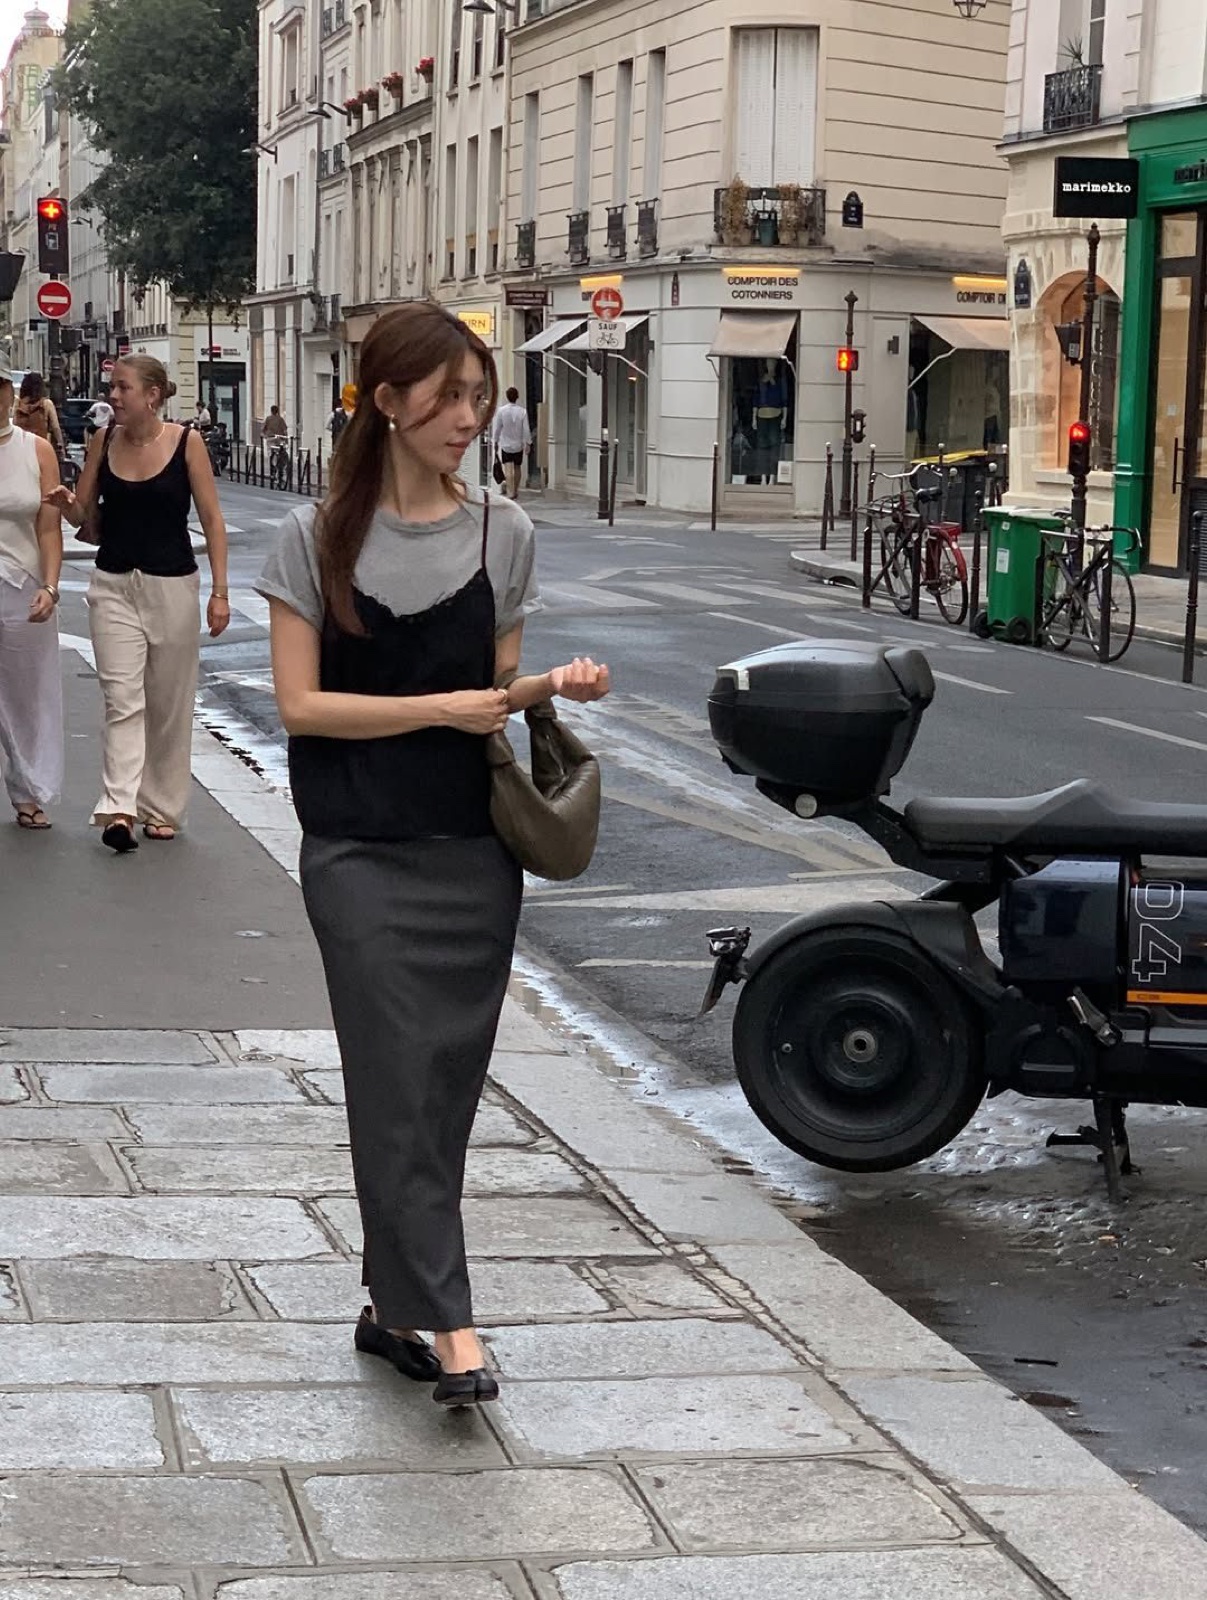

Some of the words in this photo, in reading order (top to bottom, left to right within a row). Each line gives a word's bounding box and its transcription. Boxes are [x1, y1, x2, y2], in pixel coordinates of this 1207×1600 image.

[1062, 181, 1131, 193] marimekko
[727, 276, 777, 286] COMPTOIR
[778, 277, 798, 286] DES
[731, 290, 793, 300] COTONNIERS
[598, 322, 618, 331] SAUF
[1132, 879, 1184, 982] 04
